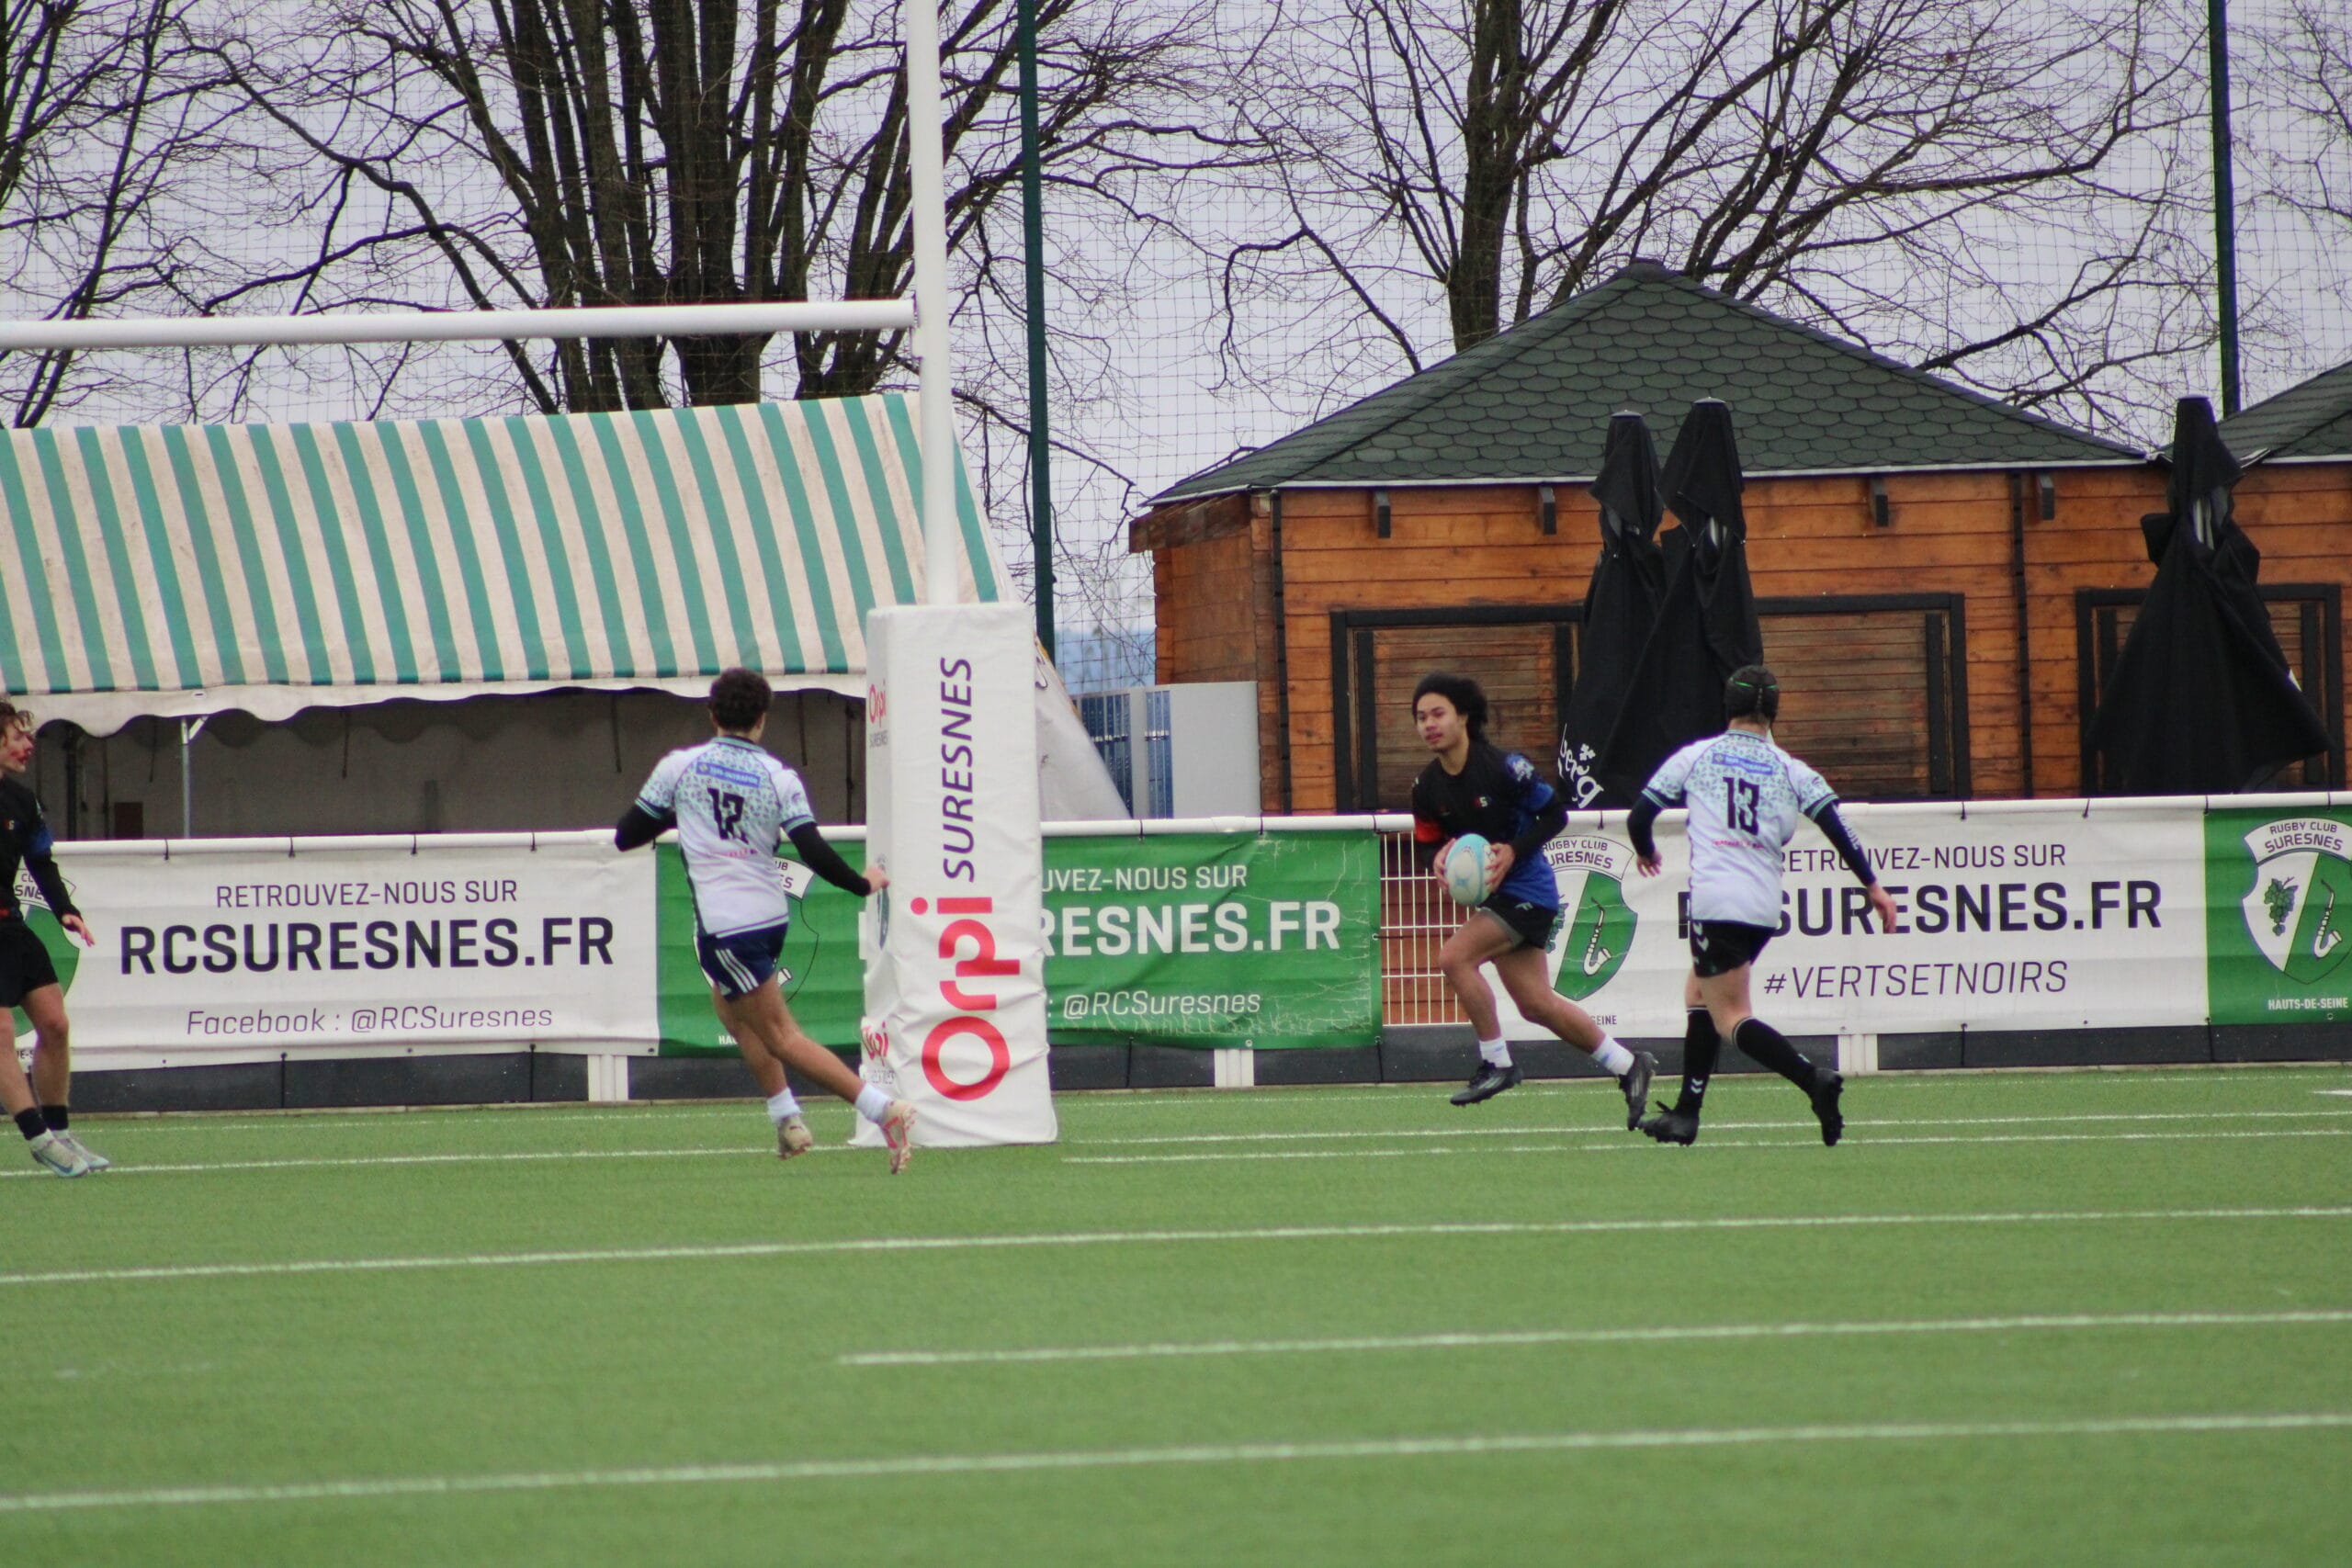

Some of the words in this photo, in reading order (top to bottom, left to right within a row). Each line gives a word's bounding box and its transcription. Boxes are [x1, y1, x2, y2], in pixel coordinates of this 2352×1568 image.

[940, 657, 975, 883] SURESNES
[707, 787, 750, 845] 12
[1723, 776, 1760, 836] 13
[2269, 821, 2307, 835] RUGBY
[2310, 821, 2338, 834] CLUB
[1544, 840, 1577, 852] RUGBY
[1580, 840, 1609, 852] CLUB
[1779, 845, 2005, 873] ETRVEZ-NOUS
[2014, 844, 2066, 867] SUR
[2264, 833, 2344, 854] SURESNES
[1549, 851, 1614, 870] URESNES
[1041, 866, 1187, 892] UVEZ-NOUS
[1195, 864, 1248, 889] SUR
[216, 881, 456, 908] RETROUVEZ-NOUS
[464, 879, 517, 903] SUR
[1678, 880, 2162, 940] SURESNES.FR
[1041, 900, 1341, 957] RESNES.FR
[119, 916, 614, 976] RCSURESNES.FR
[1764, 960, 2068, 998] #VERTSETNOIRS
[910, 897, 1021, 1101] Orpi
[1063, 989, 1262, 1020] @RCSuresnes
[2267, 997, 2349, 1010] HAUTS-DE-SEINE
[187, 1009, 325, 1035] Facebook
[351, 1005, 553, 1033] @RCSuresnes
